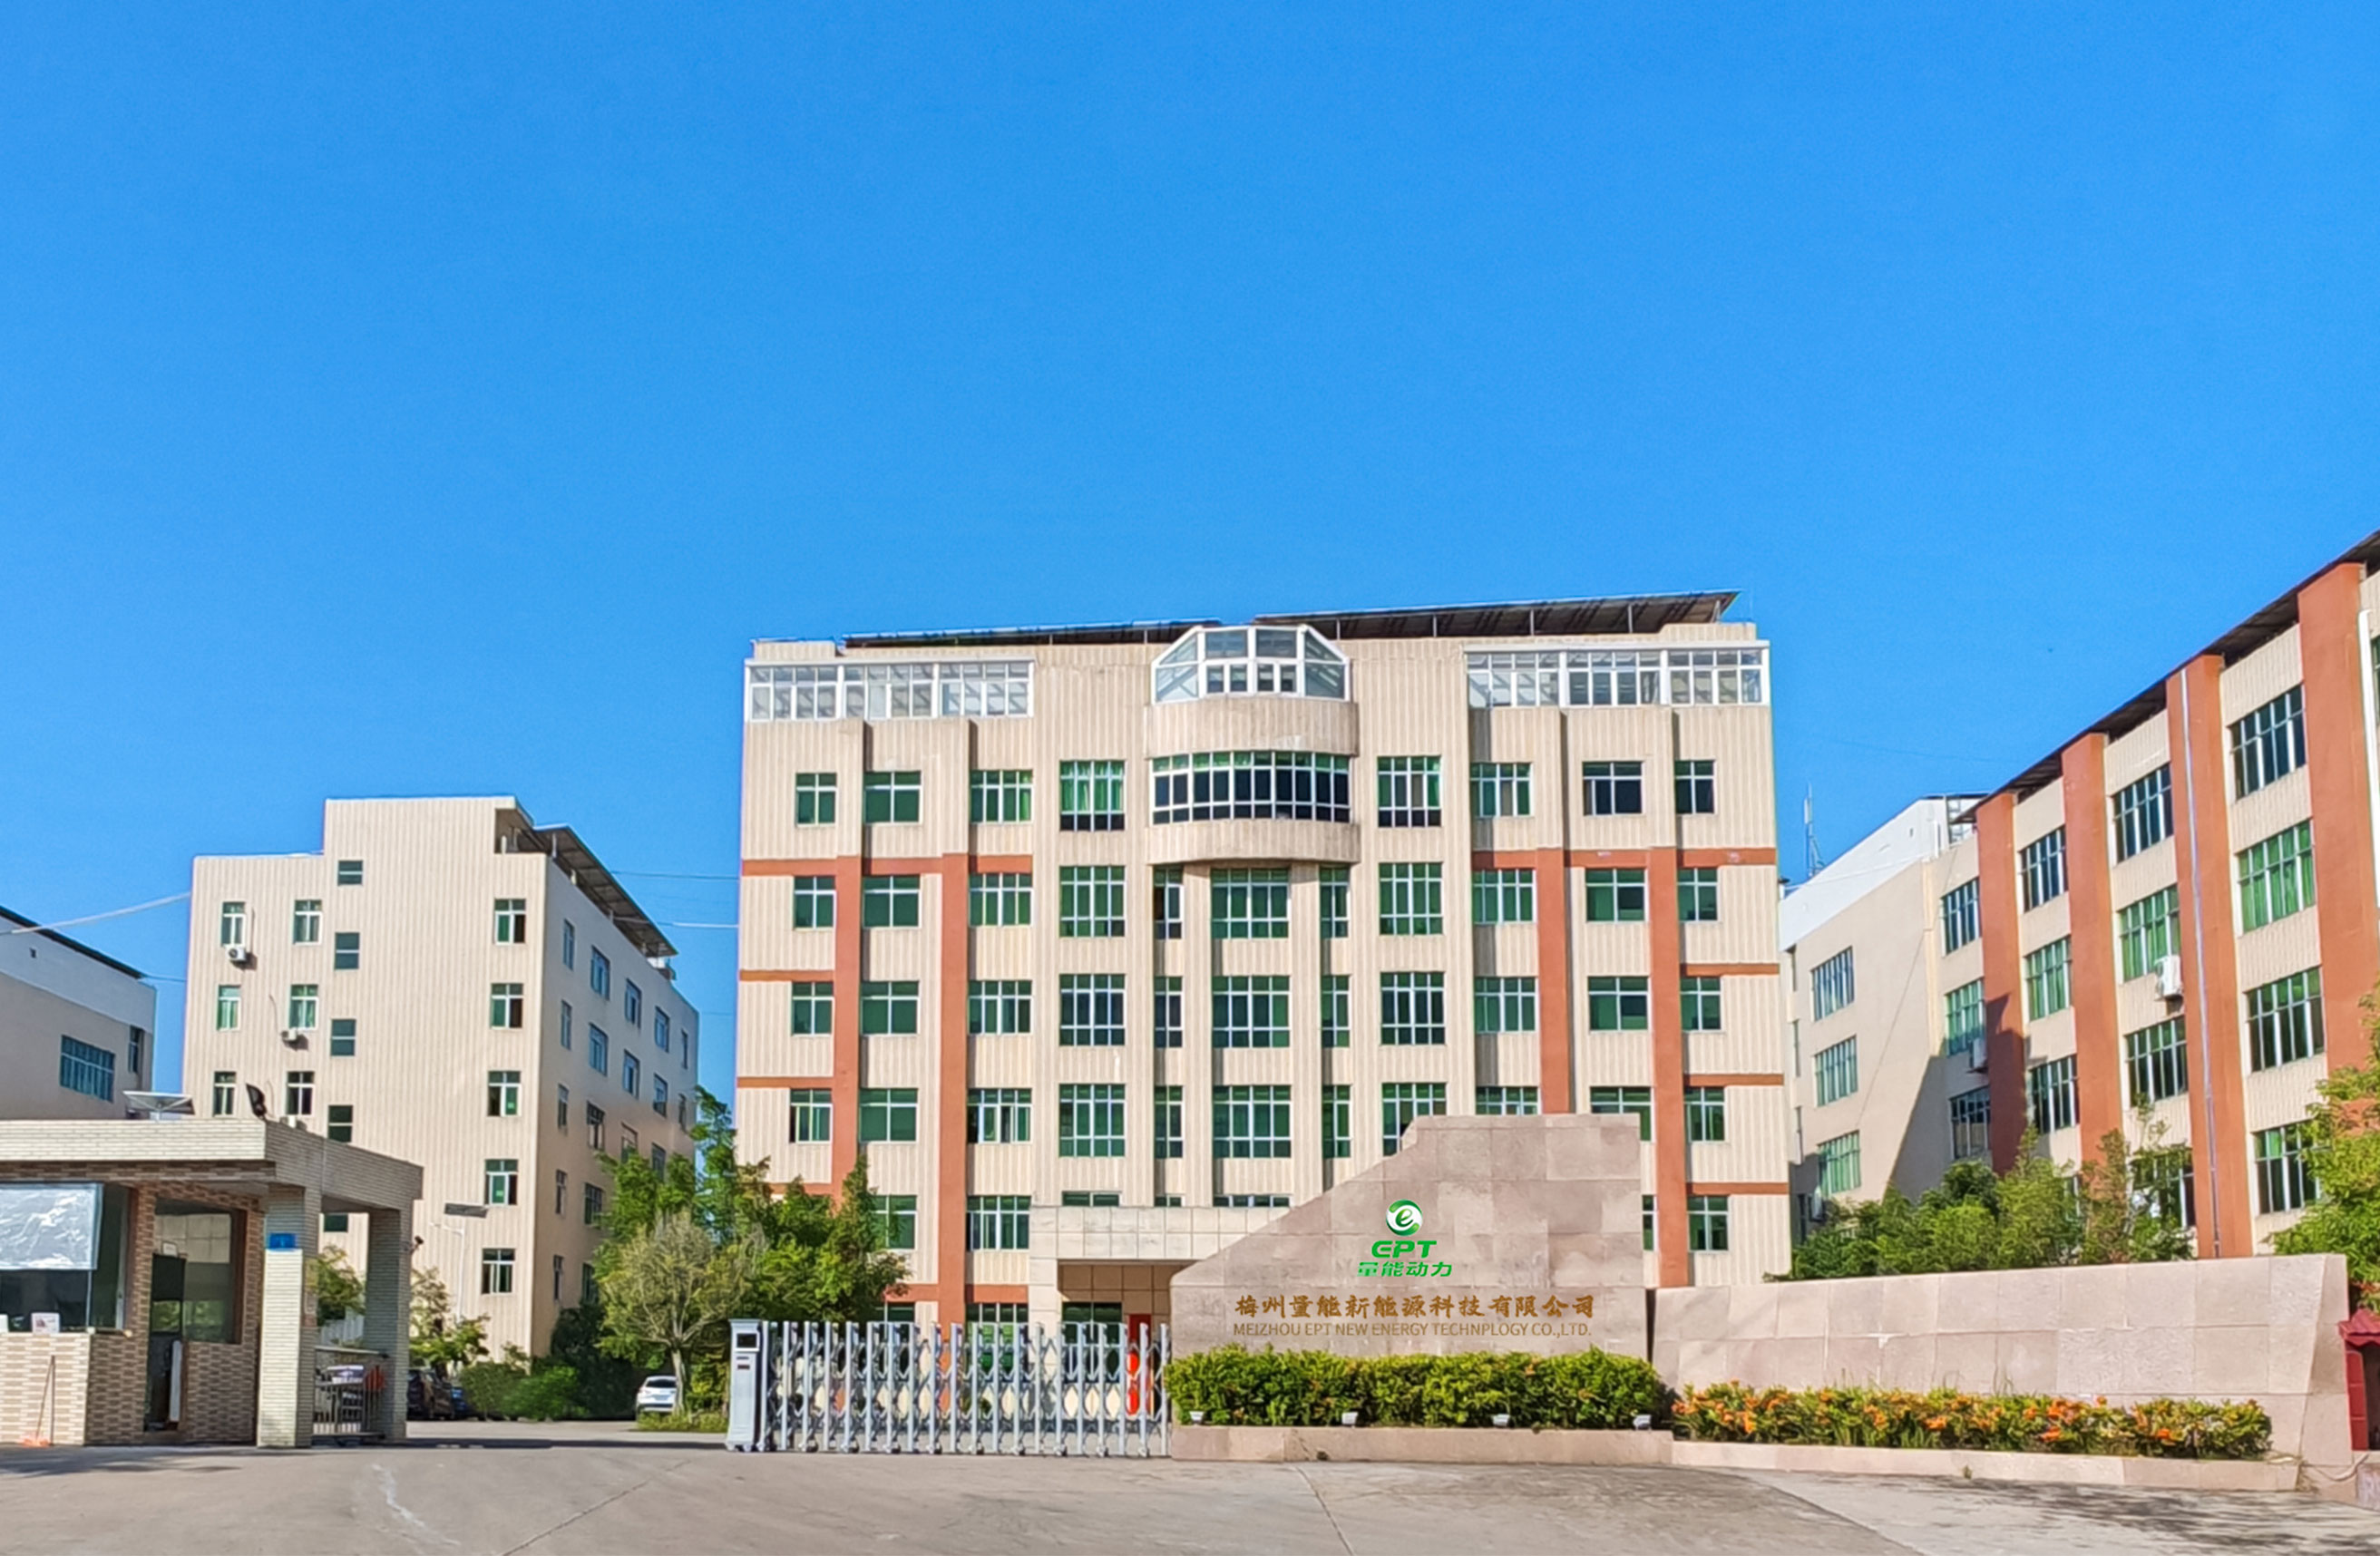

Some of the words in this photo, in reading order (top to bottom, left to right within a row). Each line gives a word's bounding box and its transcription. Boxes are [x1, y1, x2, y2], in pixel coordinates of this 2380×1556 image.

[1371, 1240, 1437, 1259] EPT
[1234, 1294, 1594, 1318] 梅州量能新能源科技有限公司
[1234, 1323, 1301, 1336] MEIZHOU
[1305, 1323, 1331, 1336] EPT
[1336, 1323, 1369, 1336] NEW
[1372, 1323, 1429, 1336] ENERGY
